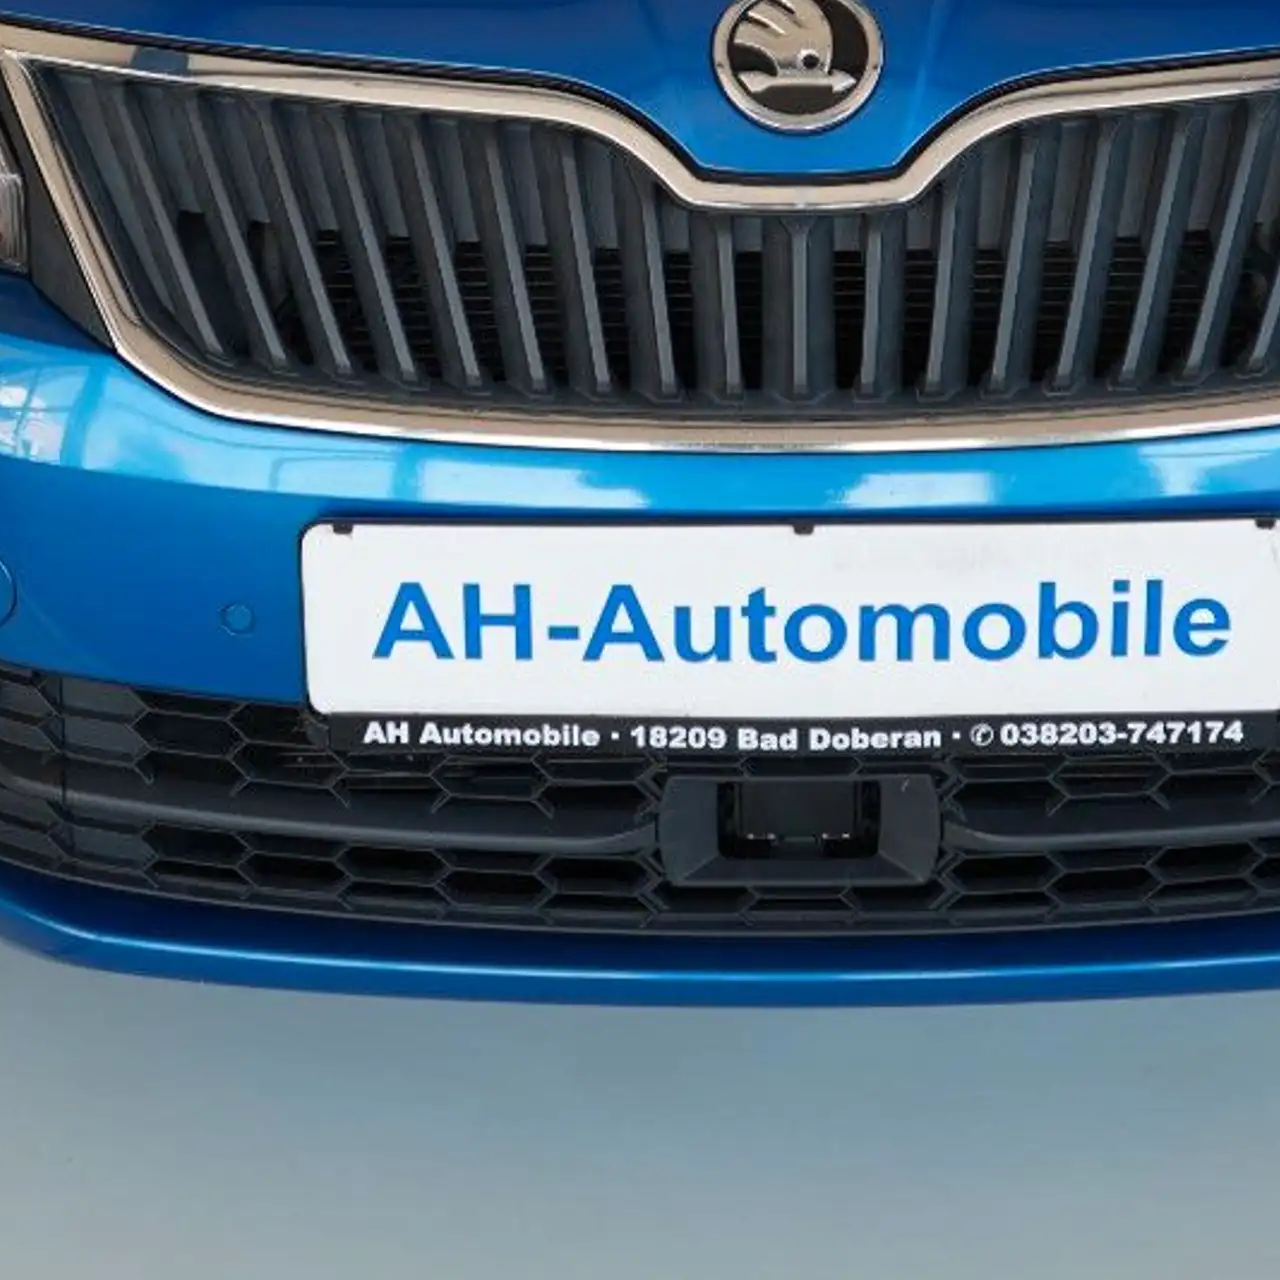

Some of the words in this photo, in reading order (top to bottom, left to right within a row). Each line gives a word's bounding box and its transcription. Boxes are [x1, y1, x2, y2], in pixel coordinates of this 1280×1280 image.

[371, 580, 1231, 663] AH-Automobile
[363, 721, 409, 745] AH
[419, 722, 601, 747] Automobile
[630, 725, 727, 750] 18209
[738, 727, 798, 752] Bad
[809, 726, 942, 751] Doberan
[999, 720, 1244, 746] 038203-747174
